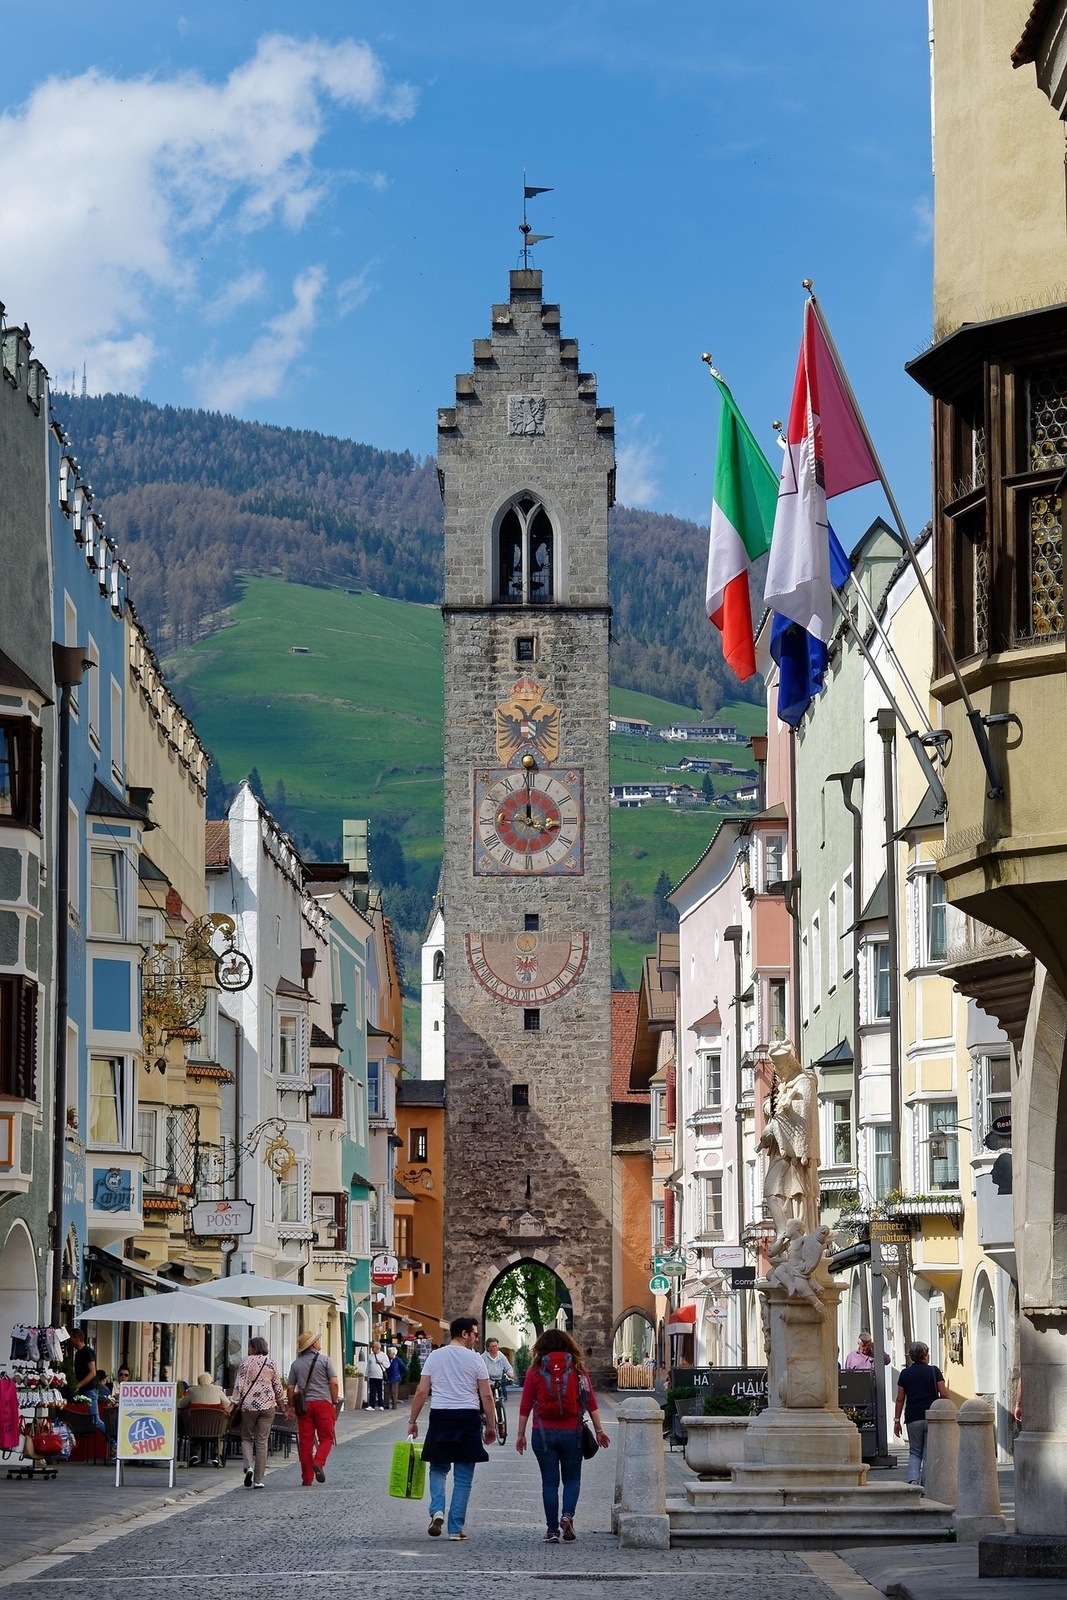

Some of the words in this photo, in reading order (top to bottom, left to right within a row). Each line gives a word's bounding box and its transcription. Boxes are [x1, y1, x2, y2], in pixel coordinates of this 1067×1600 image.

[522, 774, 535, 787] XII
[486, 794, 499, 807] X
[206, 1214, 241, 1227] POST
[122, 1386, 173, 1398] DISCOUNT
[131, 1419, 157, 1439] HS
[132, 1436, 166, 1455] SHOP
